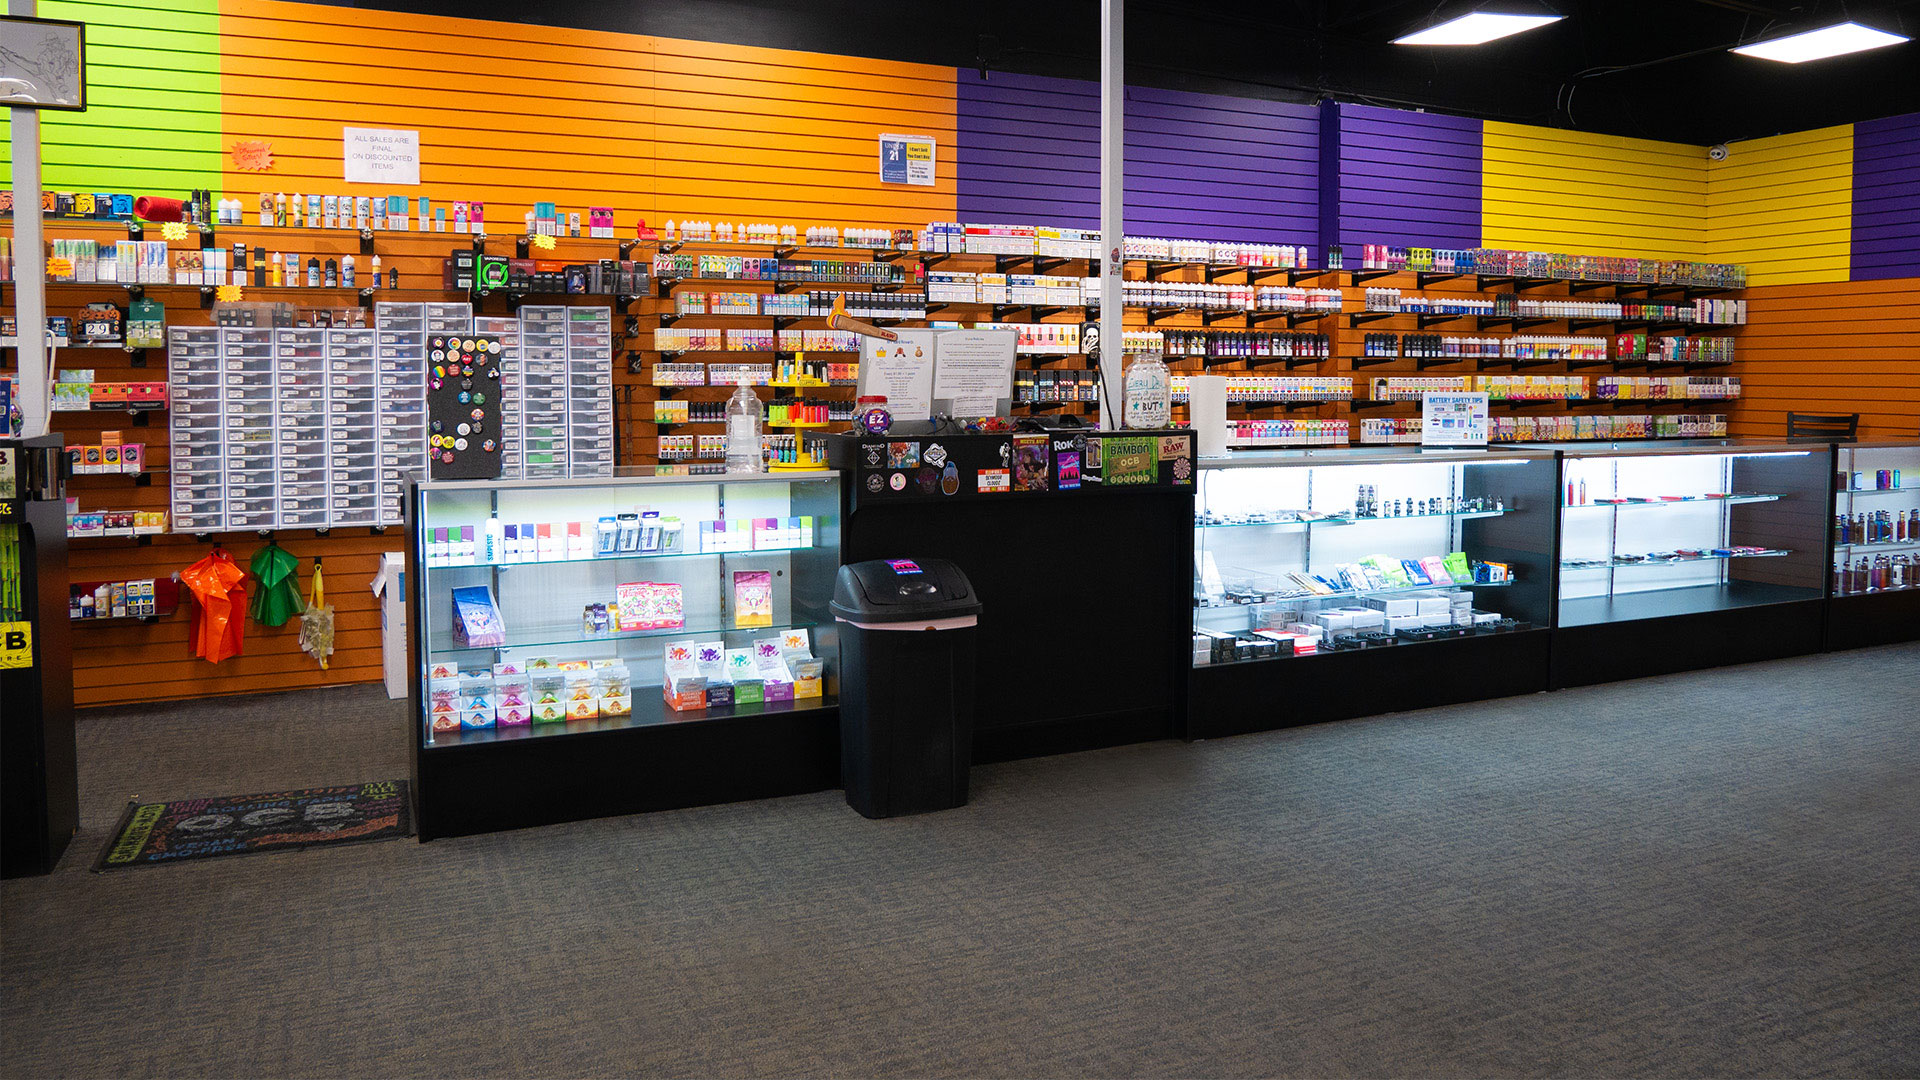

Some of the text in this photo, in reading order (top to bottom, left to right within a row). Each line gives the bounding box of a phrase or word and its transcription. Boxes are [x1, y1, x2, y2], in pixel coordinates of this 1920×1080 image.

[369, 135, 393, 144] SALES
[352, 152, 413, 162] ON DISCOUNTED
[889, 150, 899, 161] 21
[371, 162, 394, 170] ITEMS
[1142, 401, 1159, 411] BUT
[868, 414, 884, 424] EZ
[1110, 444, 1150, 455] BAMBOO
[1162, 441, 1185, 454] RAW
[1120, 456, 1140, 467] OCB
